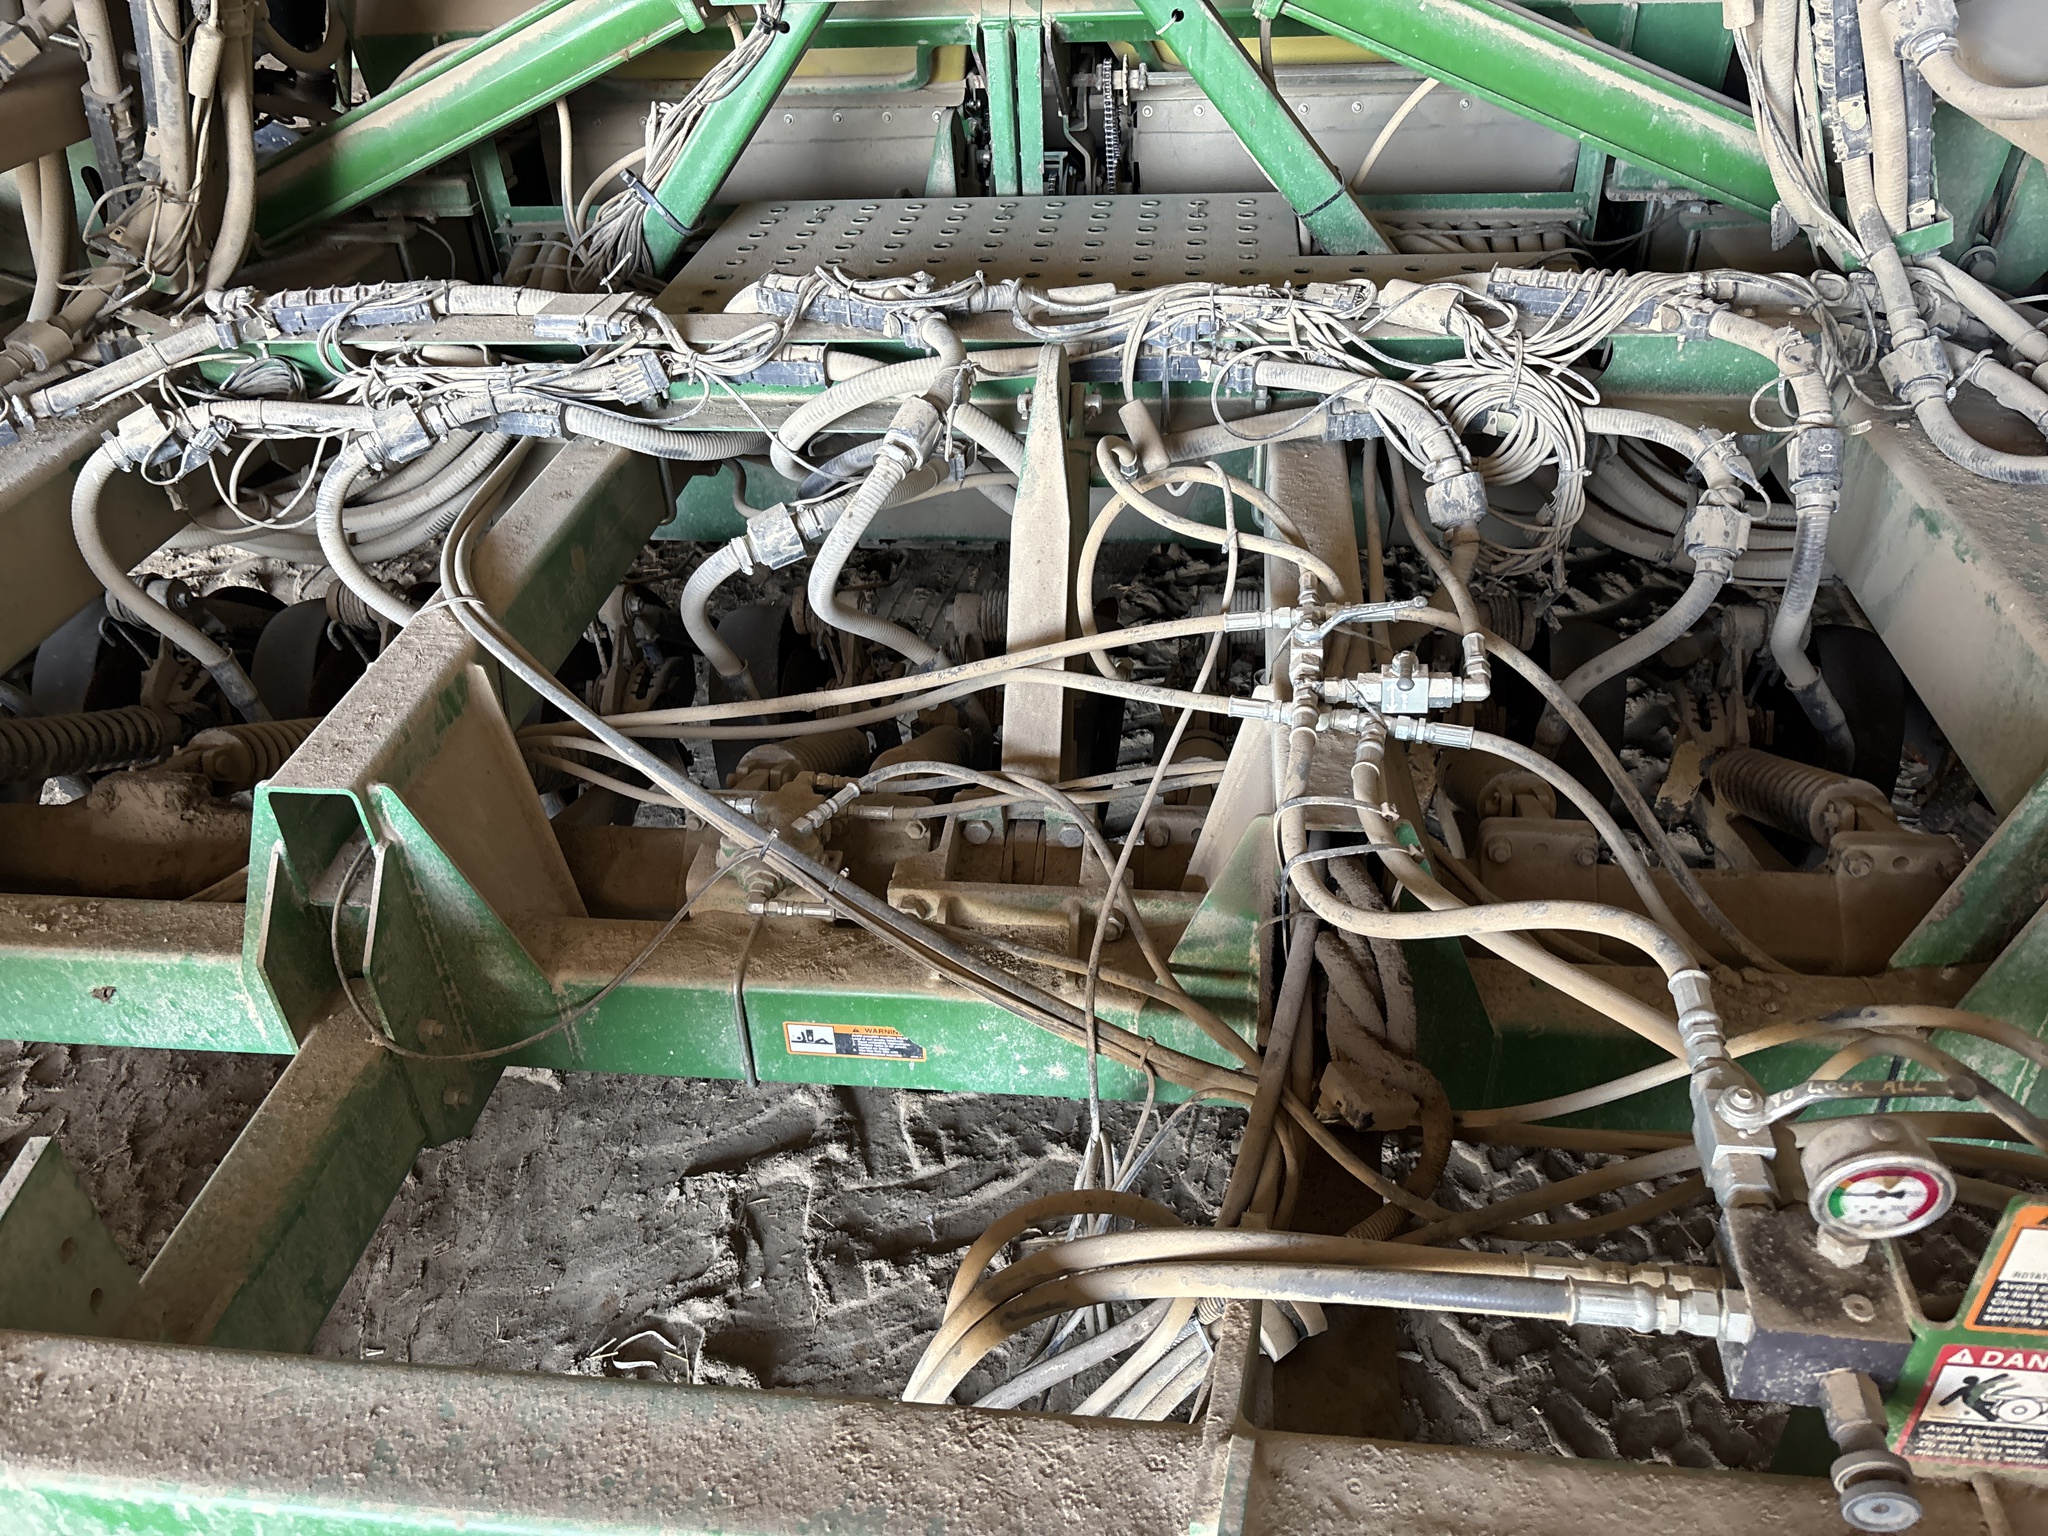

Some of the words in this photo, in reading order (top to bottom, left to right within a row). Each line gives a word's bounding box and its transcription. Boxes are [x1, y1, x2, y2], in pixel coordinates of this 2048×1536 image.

[1807, 1081, 1864, 1095] LOCK
[1881, 1081, 1928, 1095] ALL
[1997, 1282, 2038, 1292] Avoid
[1994, 1290, 2010, 1298] or
[1990, 1297, 2029, 1307] Close
[1986, 1305, 2029, 1315] before
[1982, 1314, 2042, 1326] servicing
[1926, 1424, 1963, 1434] Avoid
[1965, 1428, 2013, 1438] serious
